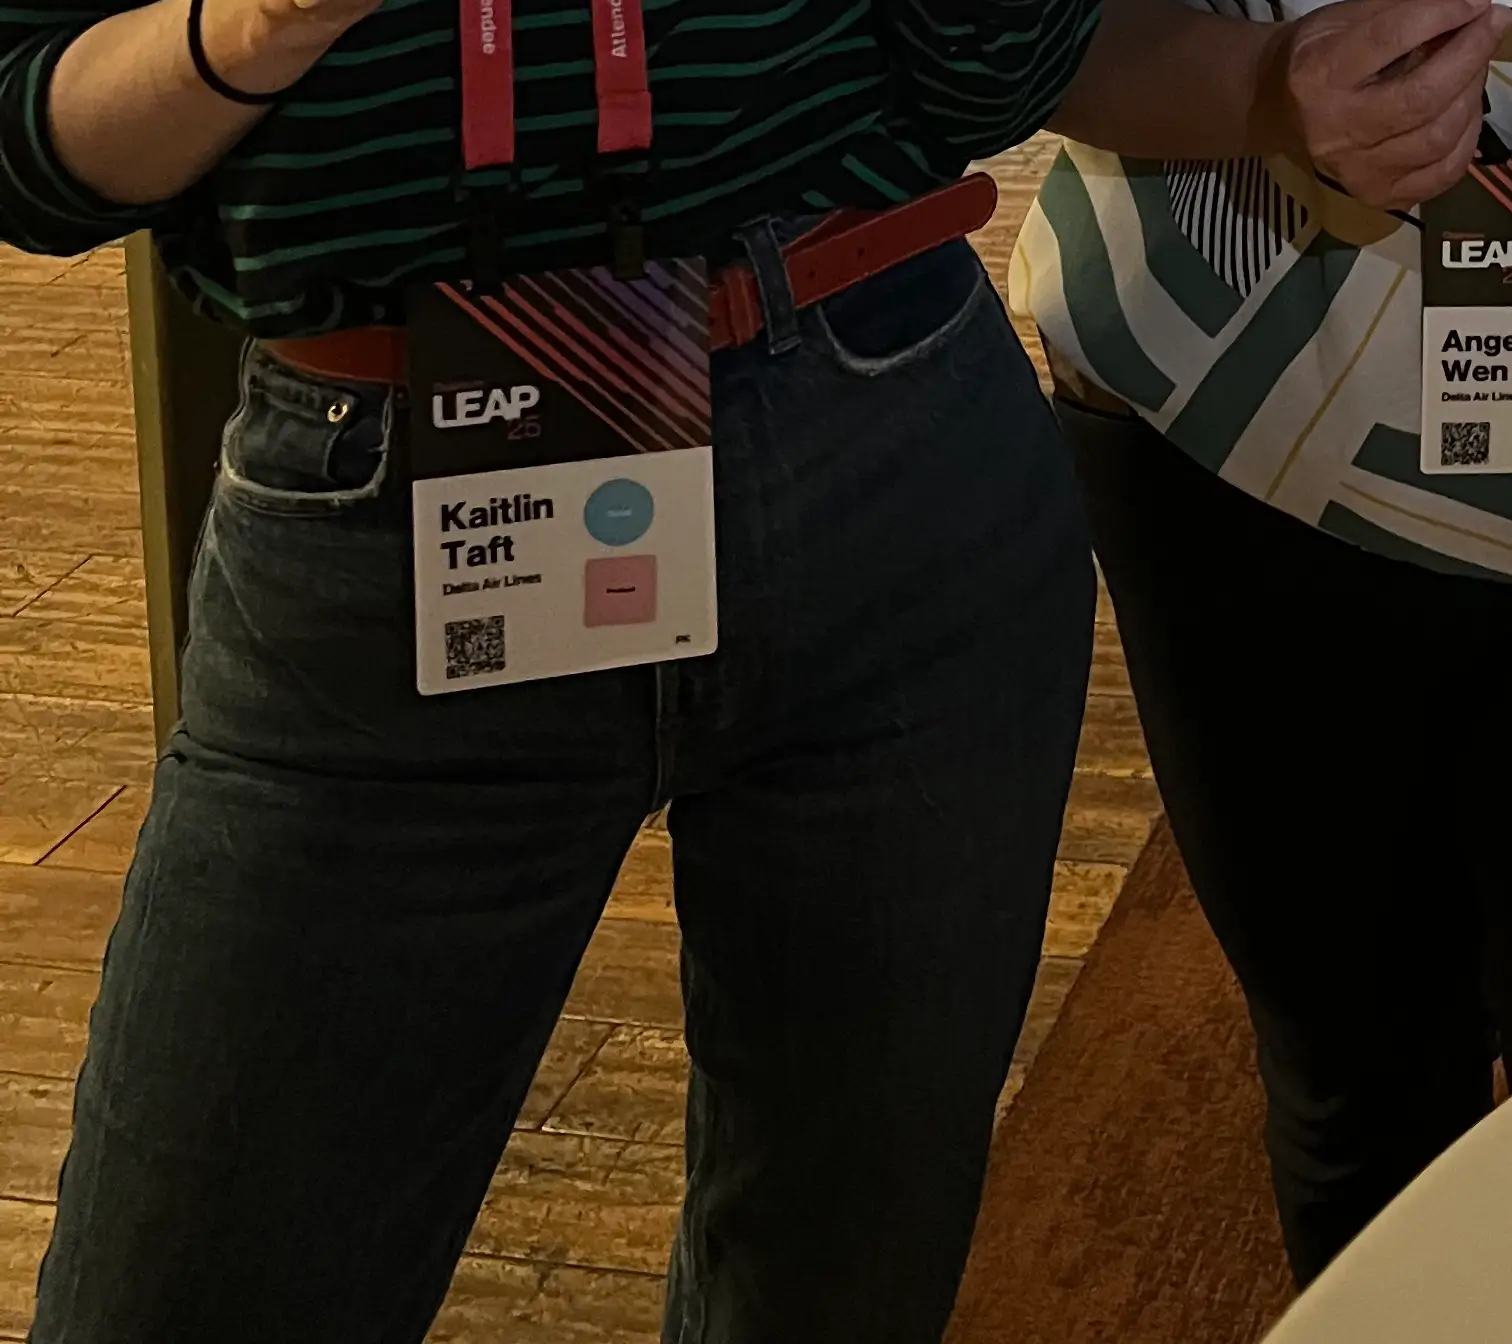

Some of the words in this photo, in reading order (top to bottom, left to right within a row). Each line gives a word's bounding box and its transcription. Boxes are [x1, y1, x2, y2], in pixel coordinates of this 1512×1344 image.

[1441, 359, 1509, 382] Wen
[432, 384, 542, 429] LEAP
[1441, 392, 1471, 402] Delta
[1473, 392, 1489, 402] Air
[441, 494, 555, 533] Kaitlin
[440, 535, 515, 569] Taft
